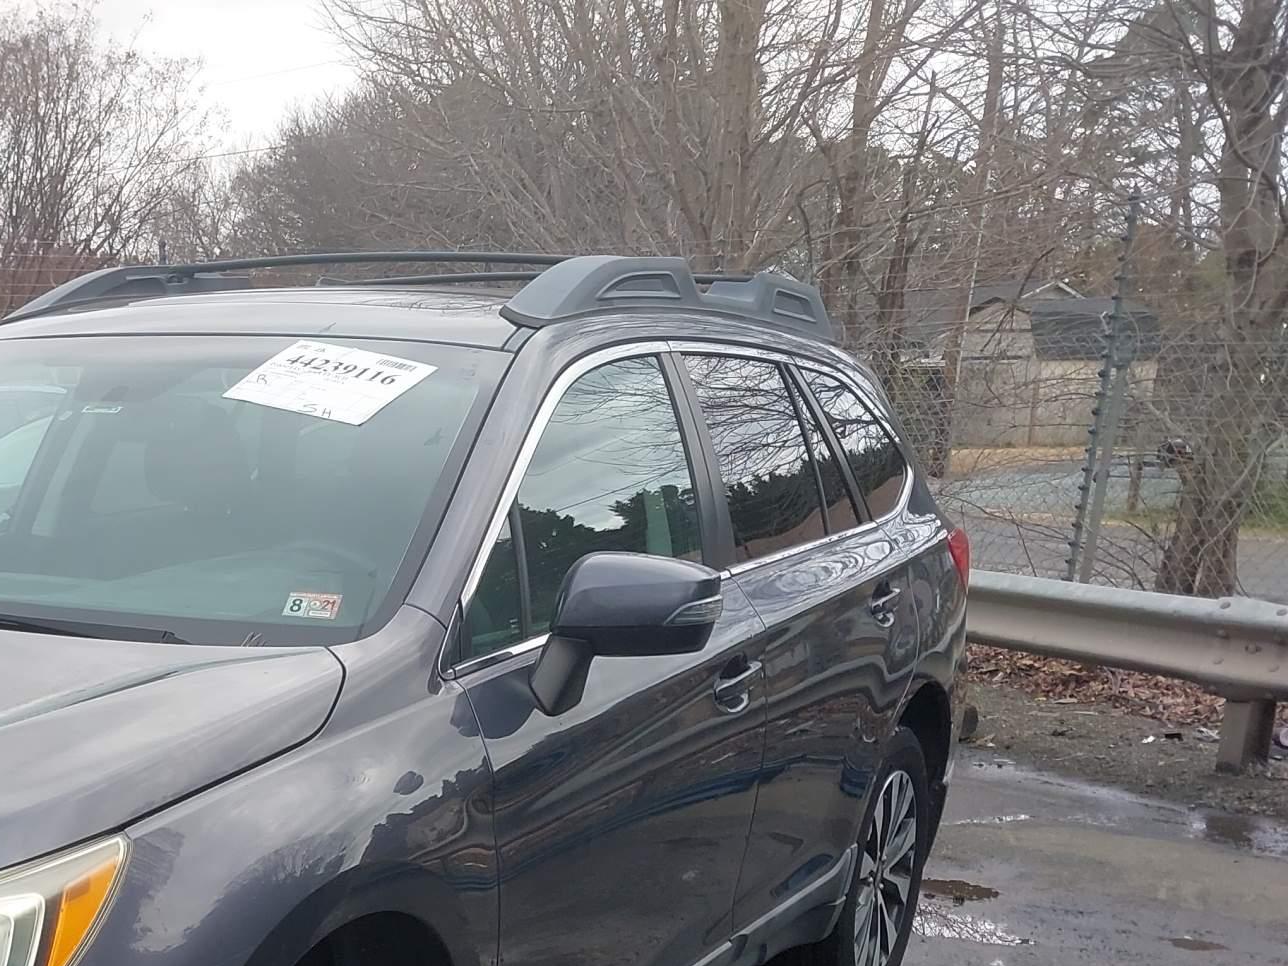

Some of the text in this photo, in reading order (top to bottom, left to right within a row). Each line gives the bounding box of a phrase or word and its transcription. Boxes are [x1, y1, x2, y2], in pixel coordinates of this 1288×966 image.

[286, 354, 403, 386] 44239116
[289, 598, 337, 613] 8 21
